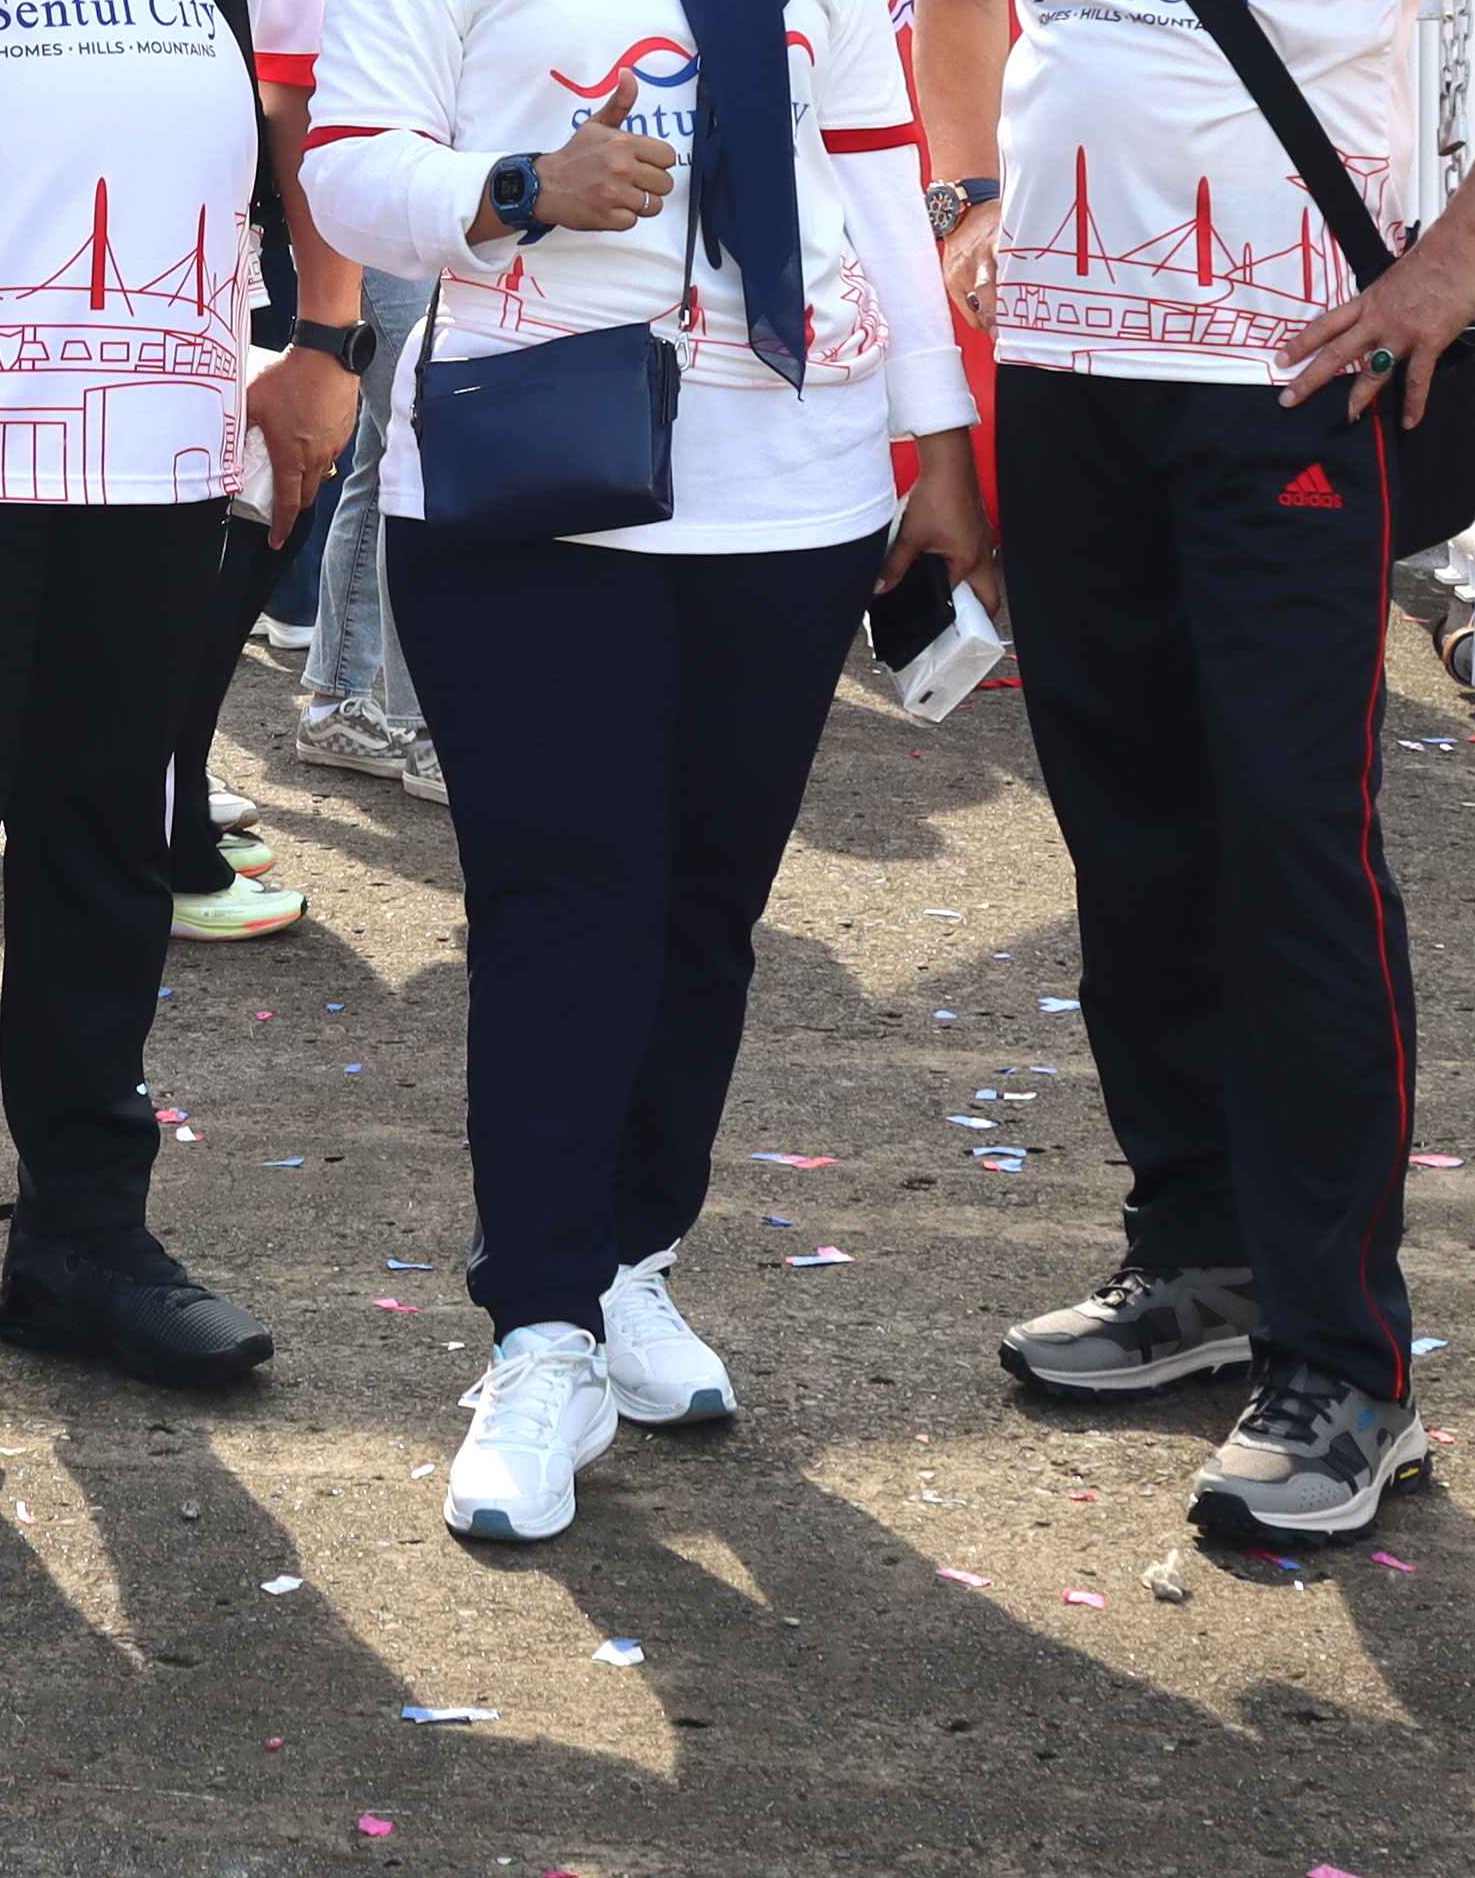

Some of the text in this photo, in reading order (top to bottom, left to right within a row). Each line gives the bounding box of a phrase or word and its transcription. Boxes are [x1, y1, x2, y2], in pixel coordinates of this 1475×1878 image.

[1079, 8, 1121, 22] HILLS
[78, 41, 125, 55] HILLS
[137, 41, 216, 58] MOUNTAINS
[1276, 492, 1345, 510] adidas
